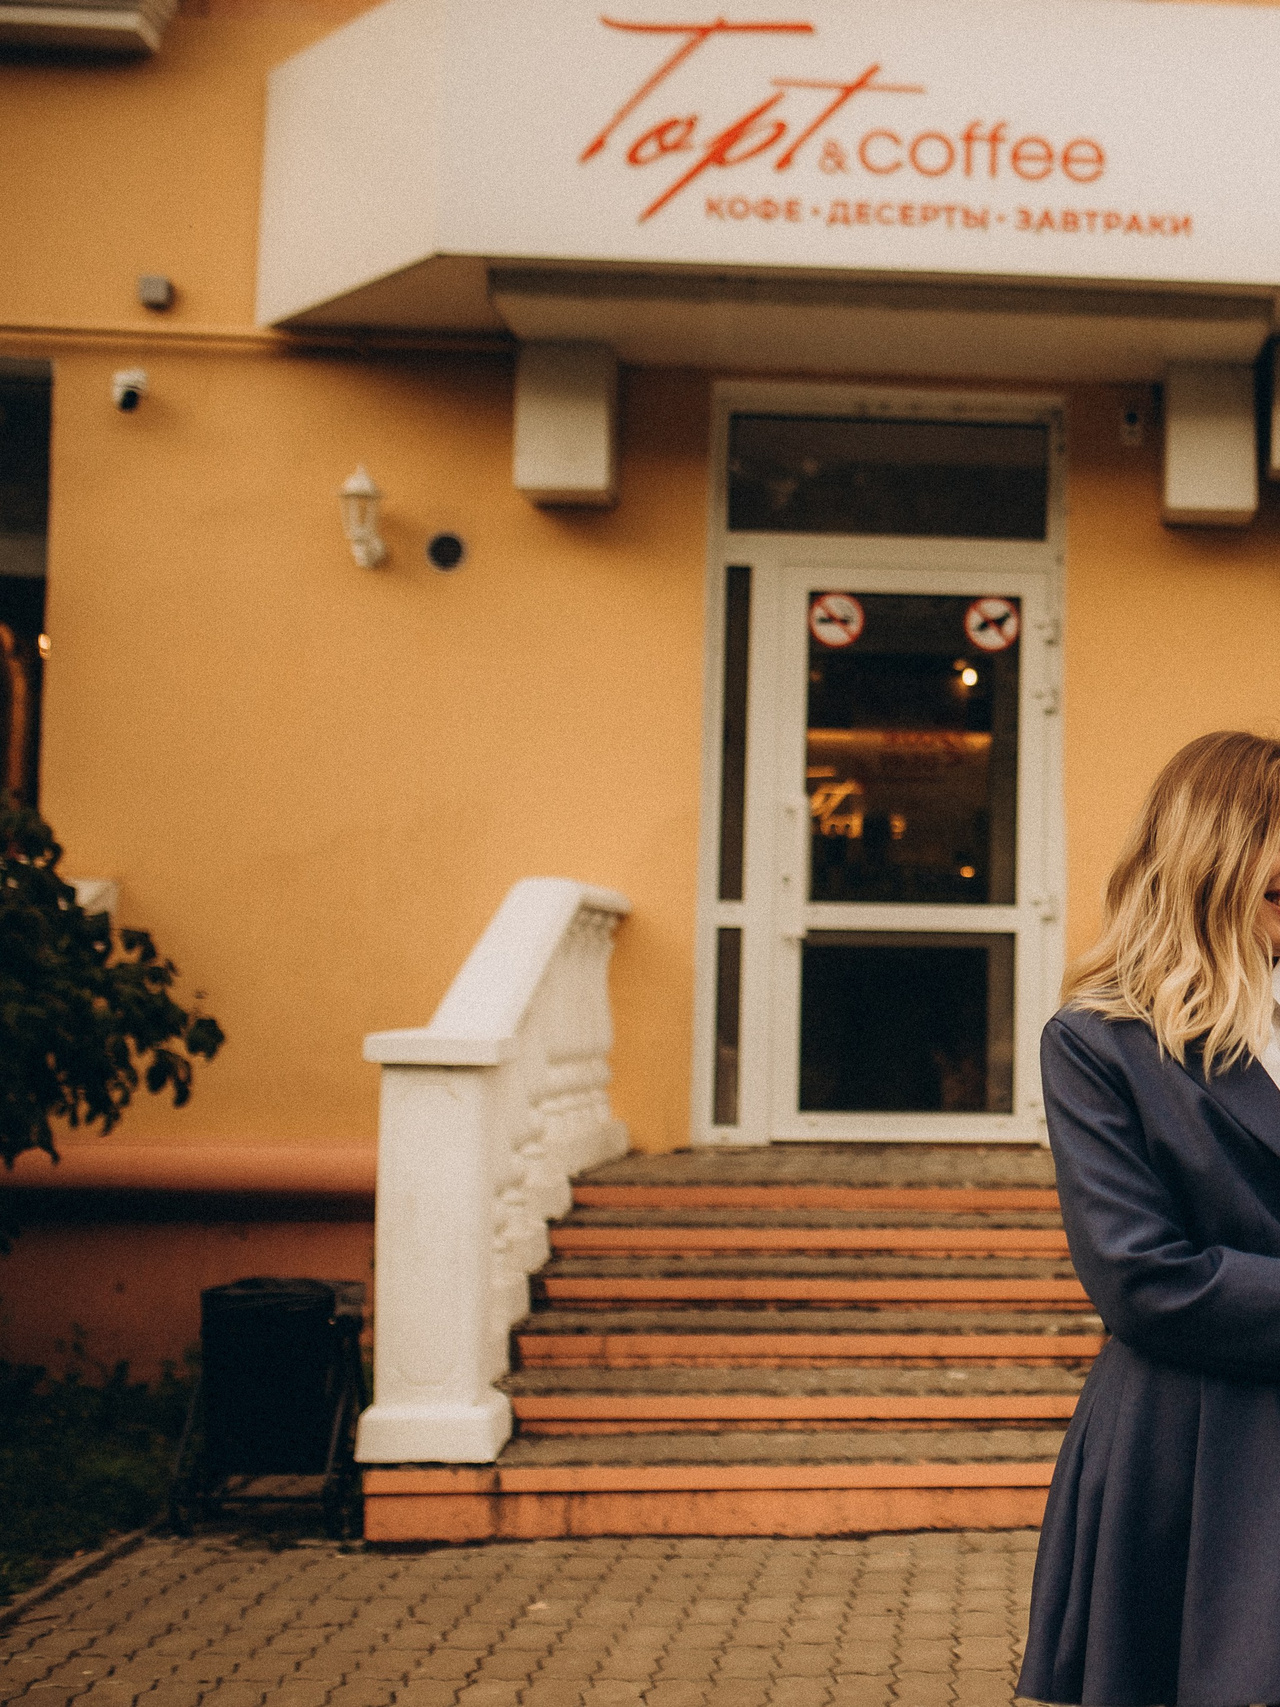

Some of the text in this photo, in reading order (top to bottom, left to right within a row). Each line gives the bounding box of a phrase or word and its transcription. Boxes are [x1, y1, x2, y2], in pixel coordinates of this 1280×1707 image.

[704, 196, 1194, 237] КОФЕ ДЕСЕРТЫ ЗАВТРАКИ
